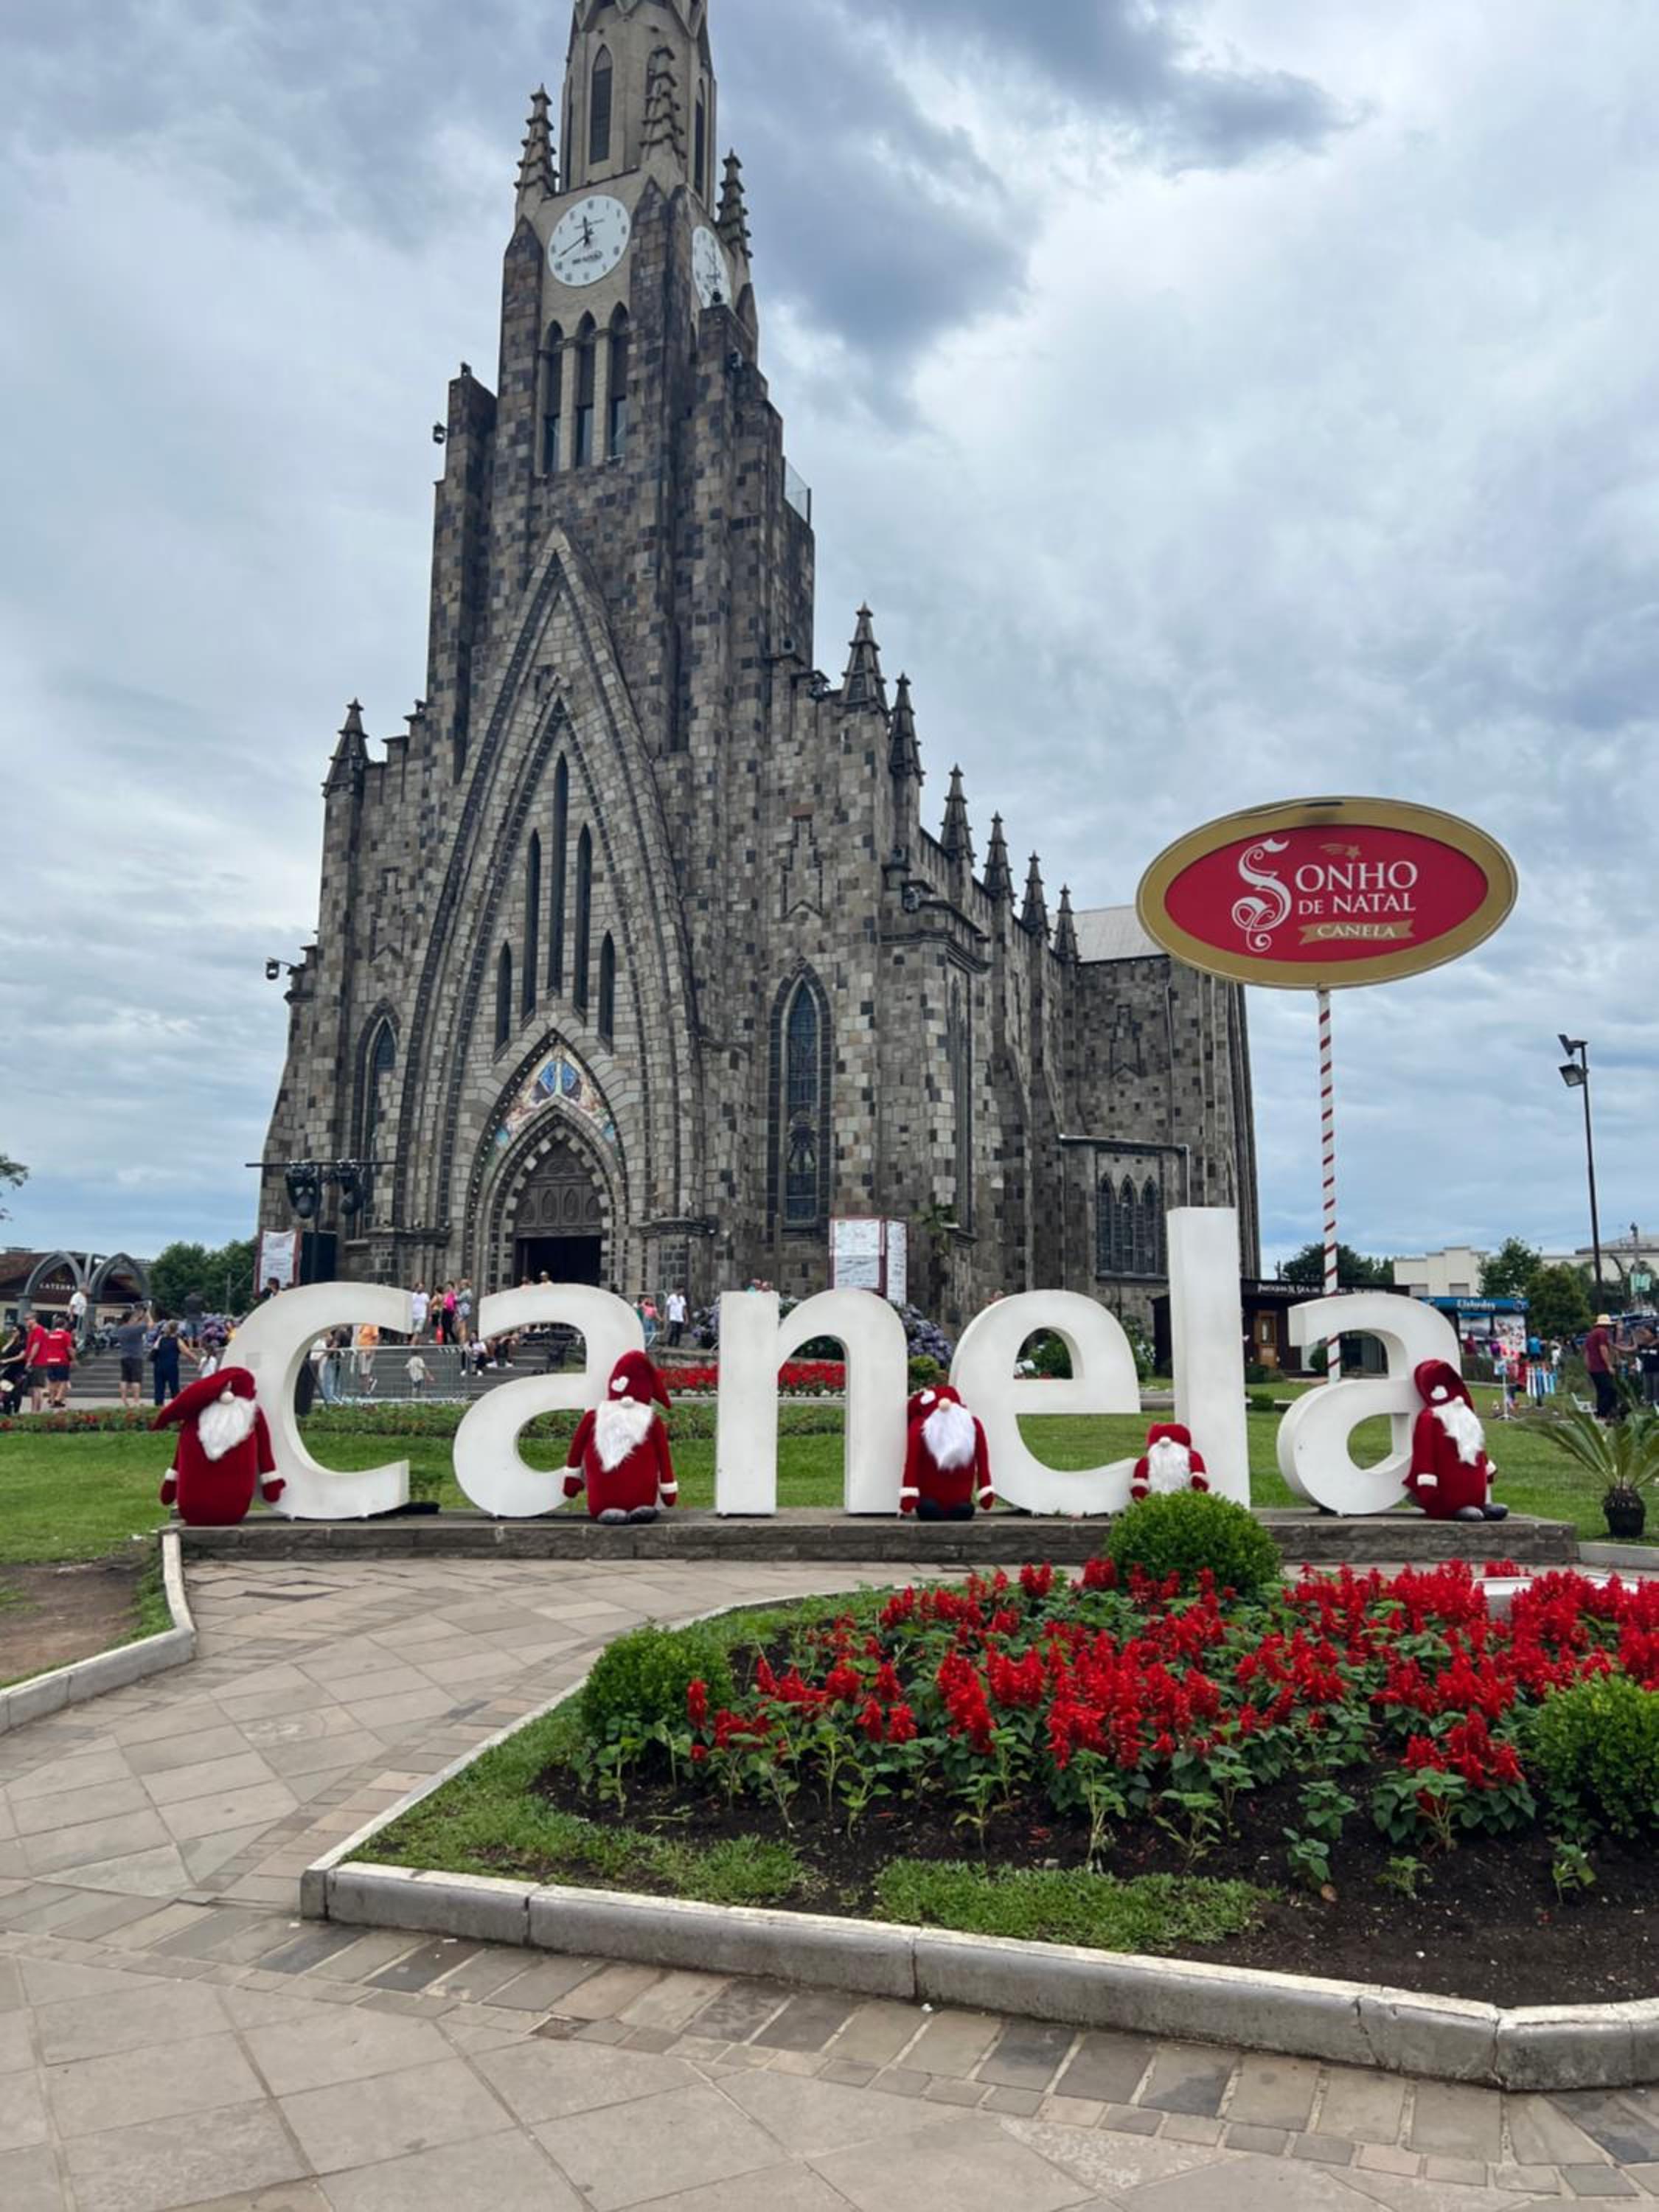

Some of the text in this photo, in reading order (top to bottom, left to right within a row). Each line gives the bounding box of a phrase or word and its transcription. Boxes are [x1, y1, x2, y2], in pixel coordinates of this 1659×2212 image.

[1298, 893, 1416, 915] DE NATAL
[1316, 925, 1396, 939] CANELA
